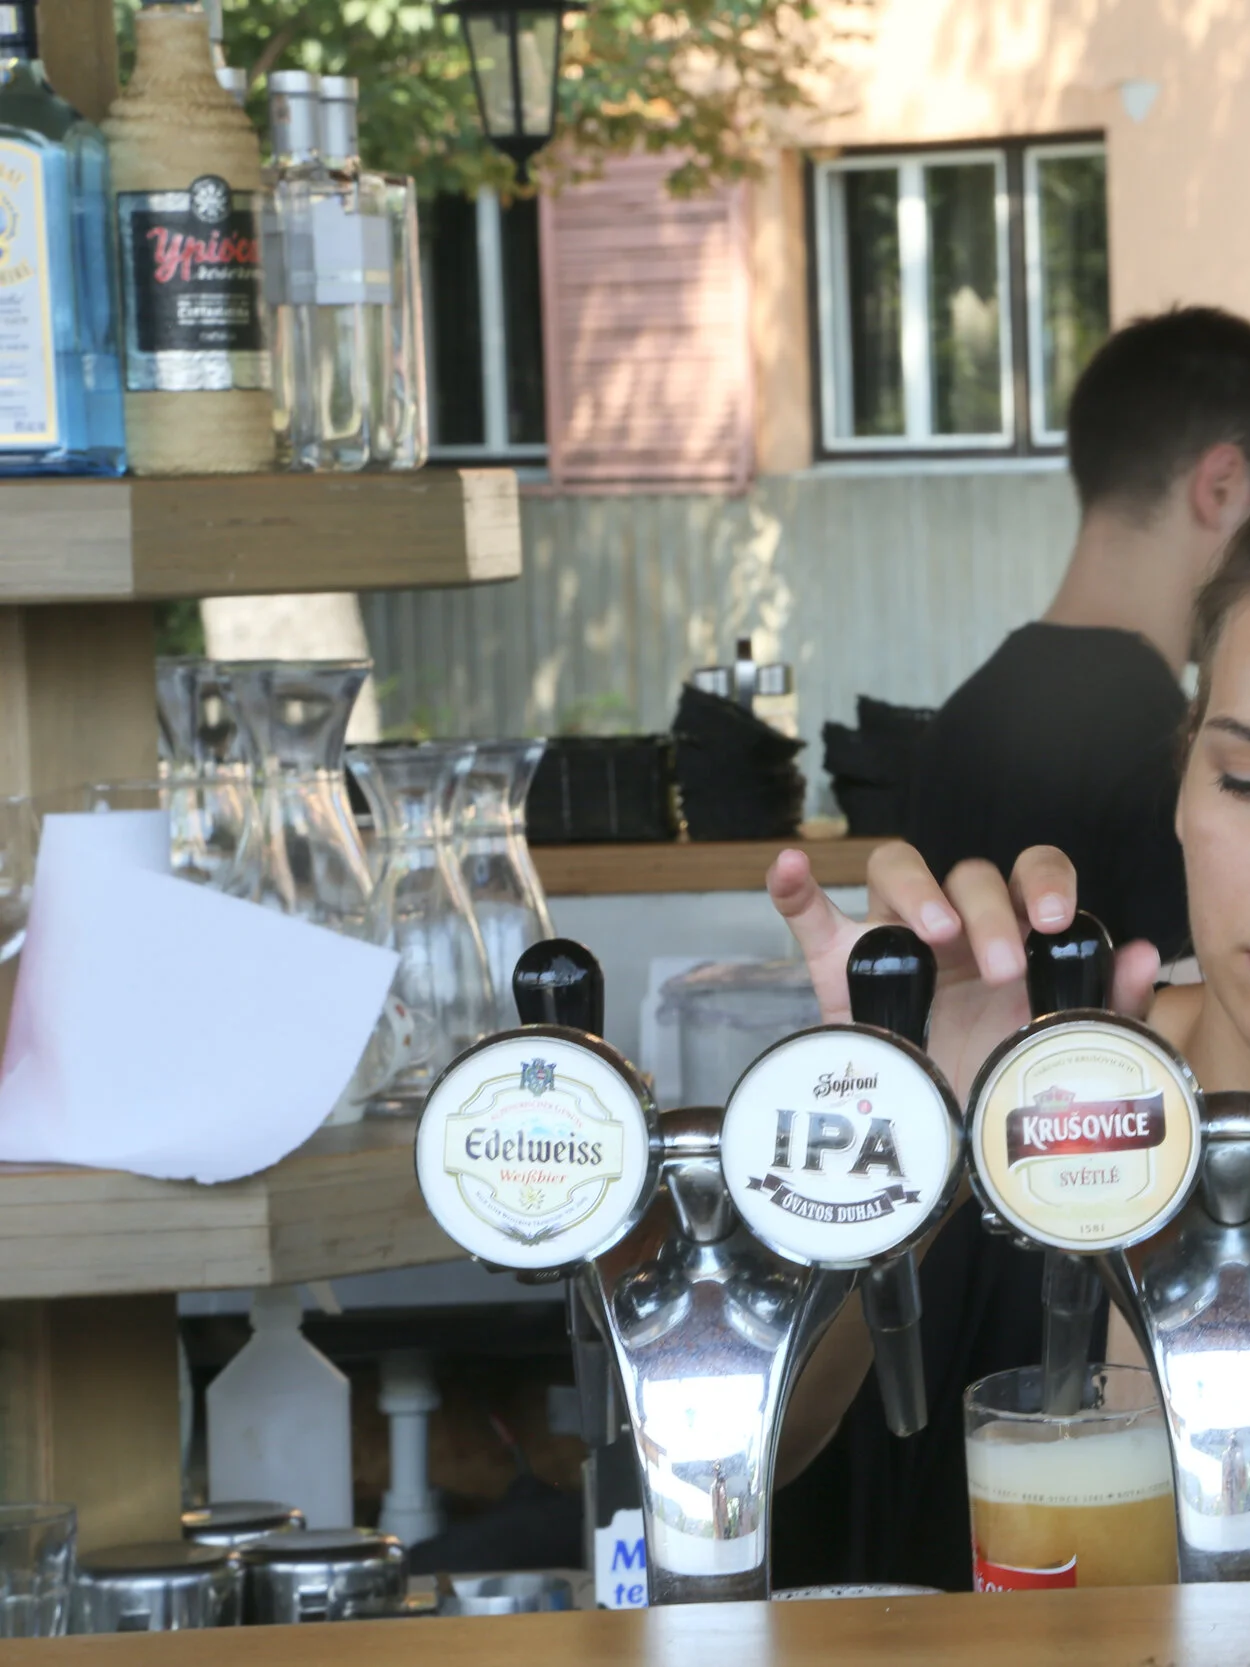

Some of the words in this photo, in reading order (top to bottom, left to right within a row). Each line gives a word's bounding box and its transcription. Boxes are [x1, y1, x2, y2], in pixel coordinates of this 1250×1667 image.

[813, 1071, 880, 1100] Soproni
[465, 1127, 604, 1166] Edelweiss
[769, 1108, 907, 1179] IPA
[1022, 1111, 1151, 1151] KRUŠOVICE
